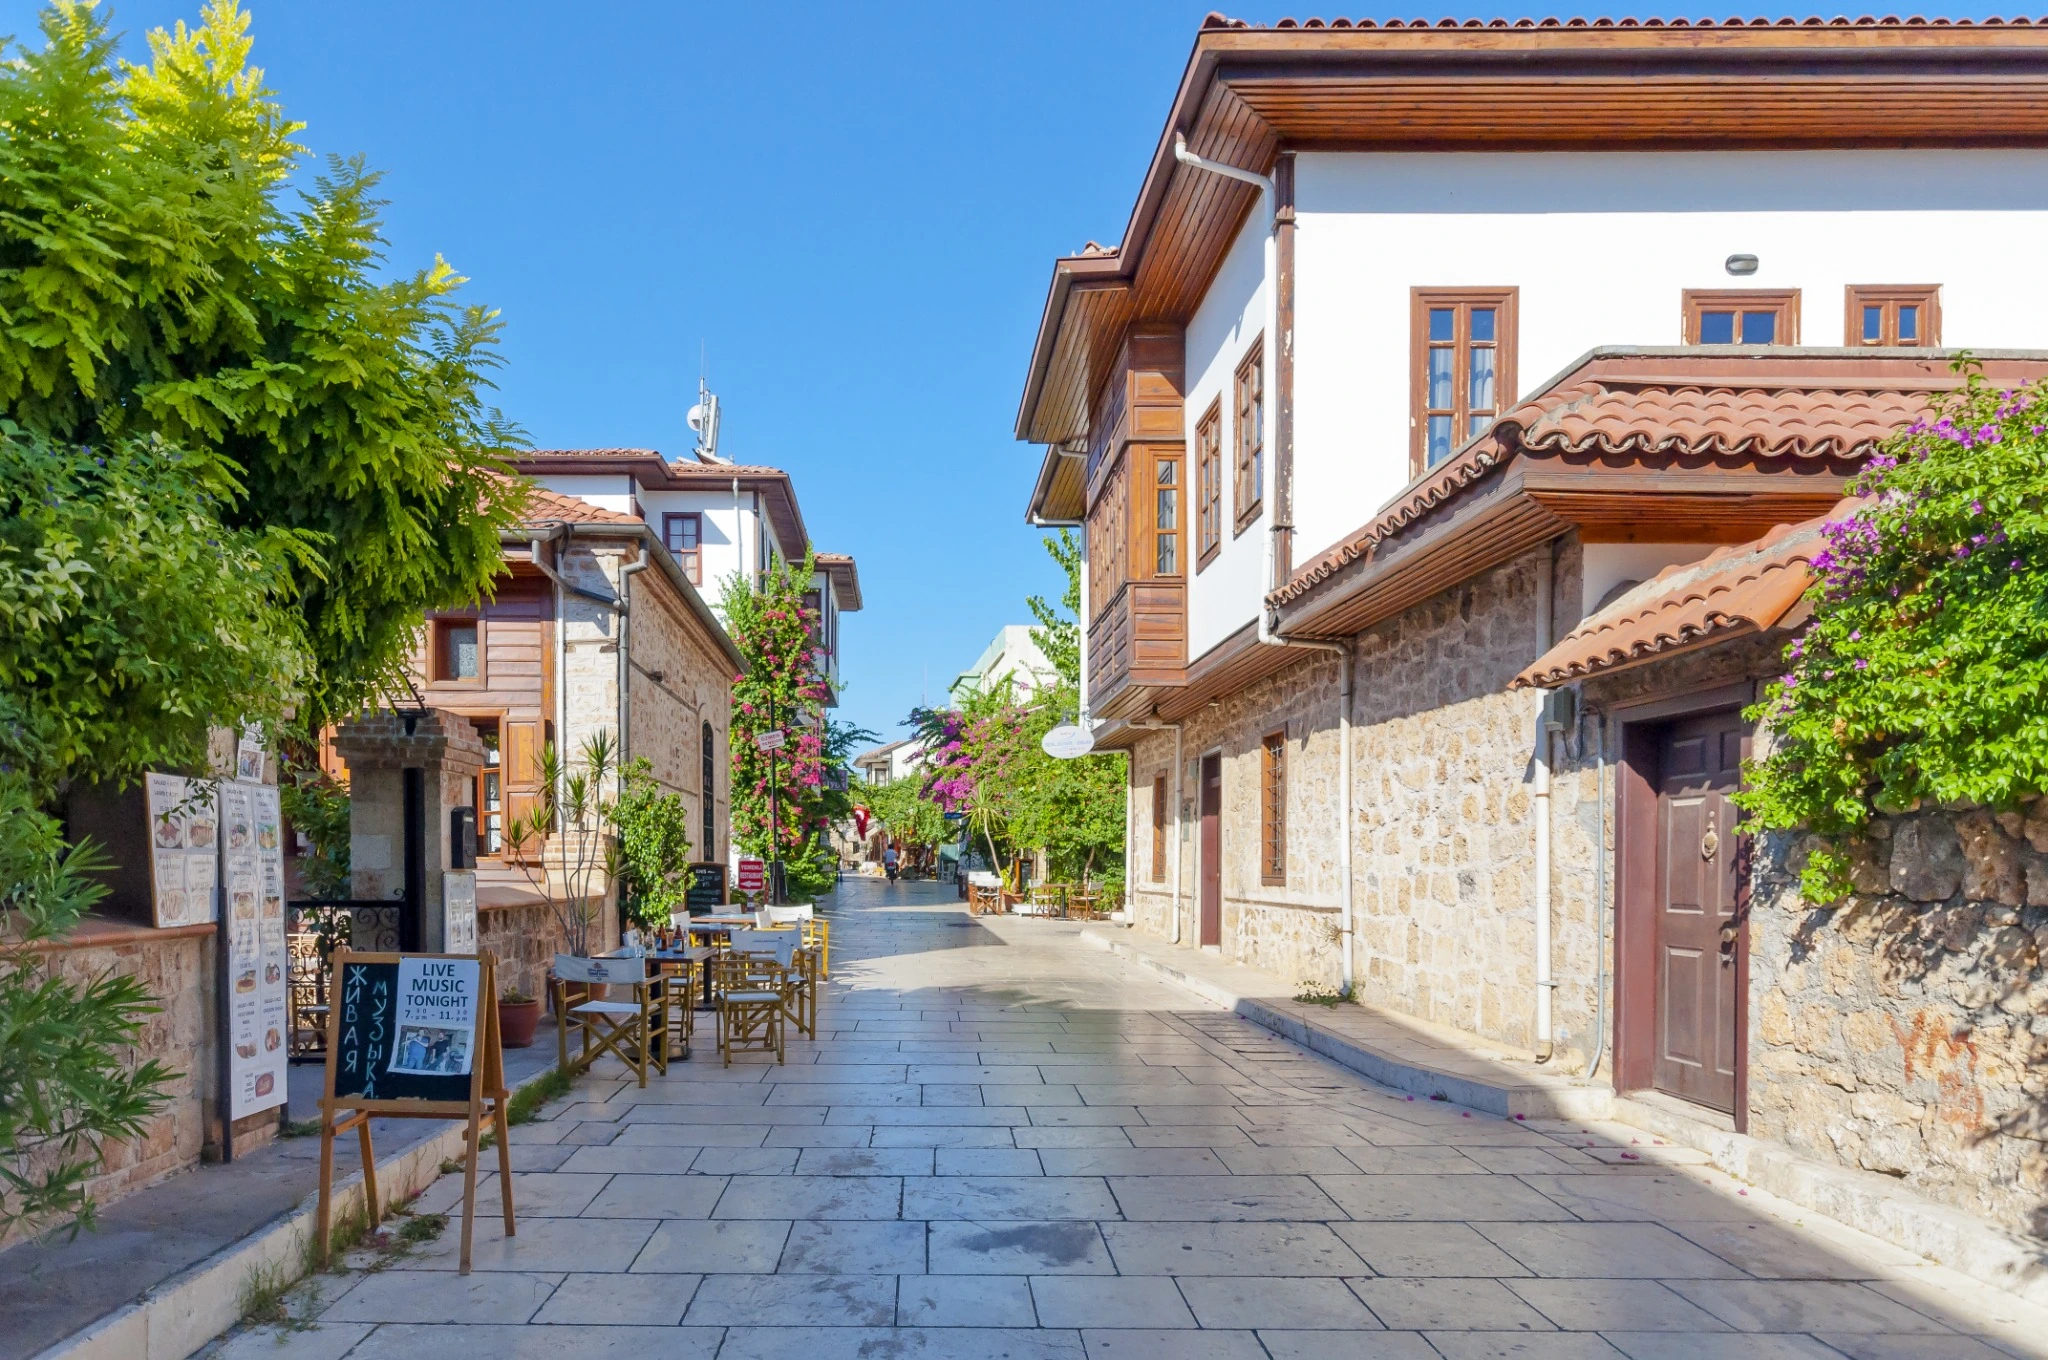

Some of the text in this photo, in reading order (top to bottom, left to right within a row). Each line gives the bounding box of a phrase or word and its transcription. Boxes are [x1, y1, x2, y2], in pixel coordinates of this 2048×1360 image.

[422, 963, 456, 977] LIVE
[412, 978, 465, 993] MUSIC
[406, 994, 469, 1008] TONIGHT
[344, 965, 367, 1073] ЖИВАЯ
